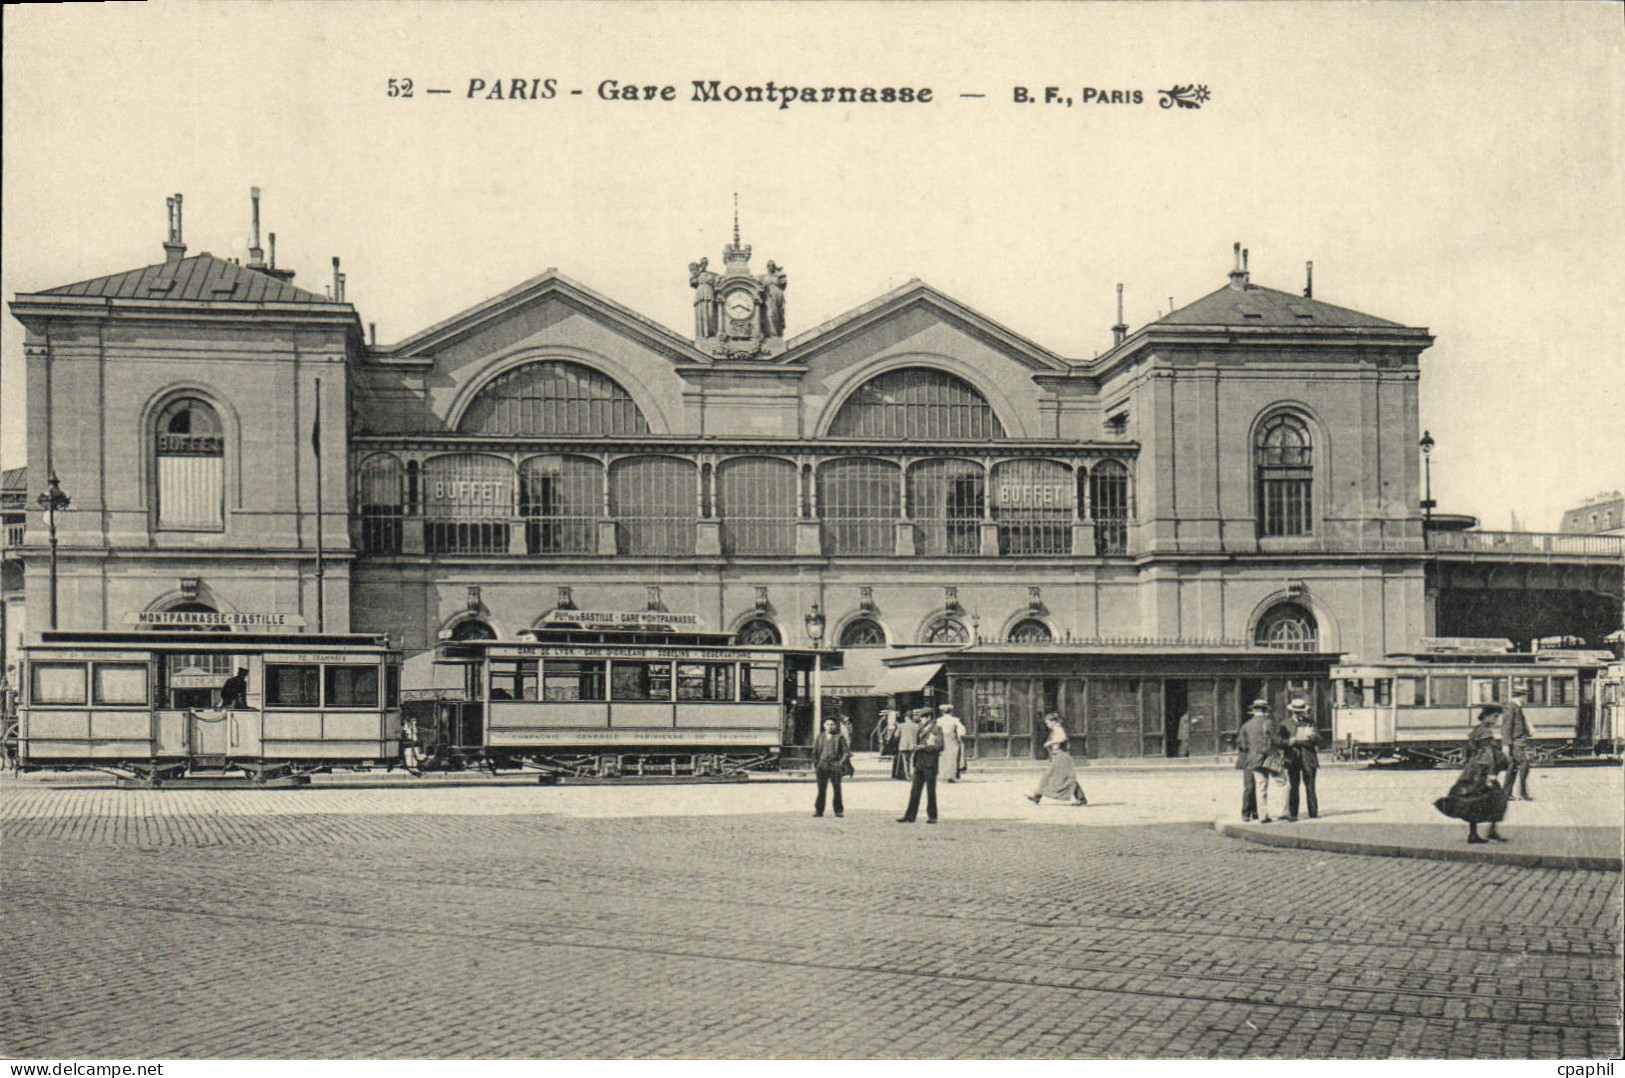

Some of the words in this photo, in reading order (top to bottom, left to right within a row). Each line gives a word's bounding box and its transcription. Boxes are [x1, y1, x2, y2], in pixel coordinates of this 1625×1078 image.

[435, 480, 503, 499] BUFFET
[1001, 485, 1062, 502] BUFFET
[580, 612, 614, 622] BASTILLE
[621, 613, 640, 623] GARE
[641, 614, 697, 625] MONTPARNASSE
